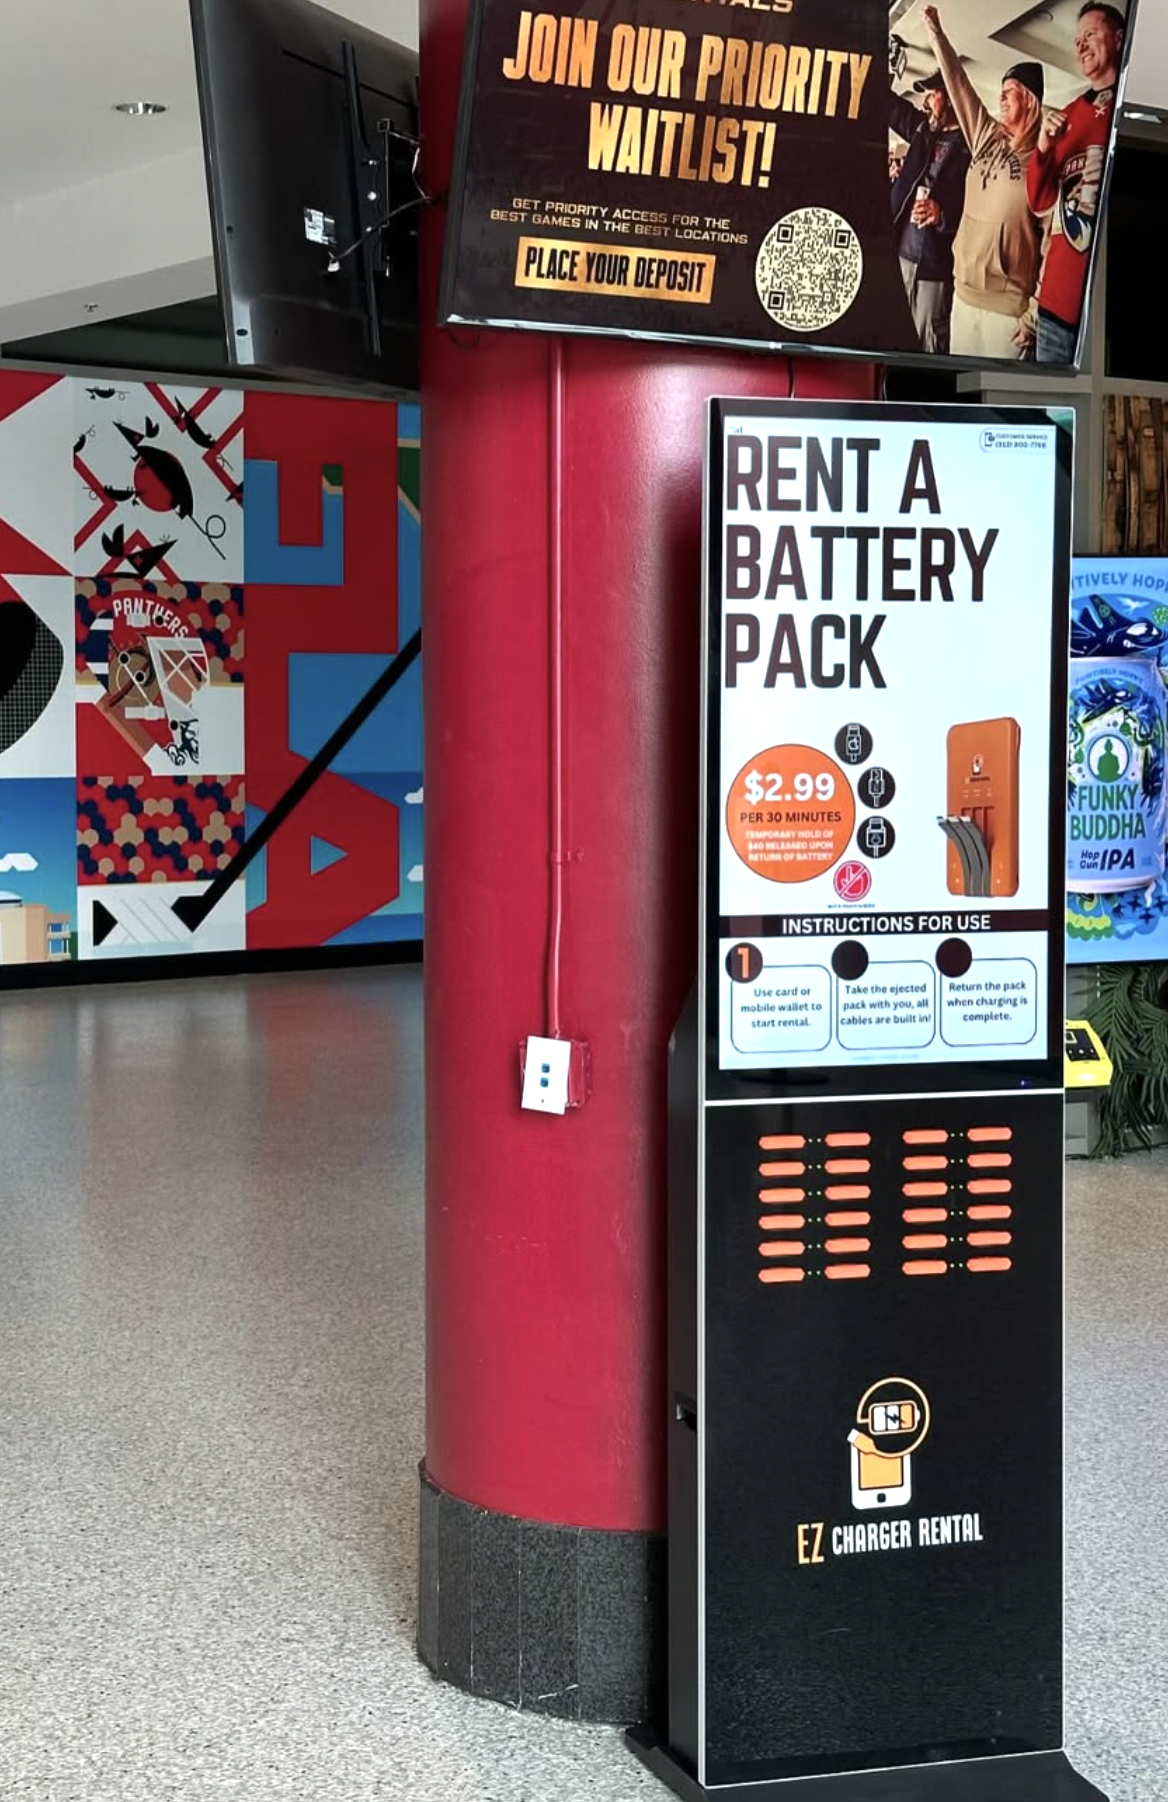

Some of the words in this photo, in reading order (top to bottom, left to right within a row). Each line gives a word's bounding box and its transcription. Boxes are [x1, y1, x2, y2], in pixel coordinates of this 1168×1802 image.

[502, 11, 598, 88] JOIN
[607, 24, 686, 99] OUR
[695, 34, 872, 120] PRIORITY
[588, 102, 777, 188] WAITLIST!
[512, 198, 541, 211] GET
[545, 202, 608, 218] PRIORITY
[612, 208, 667, 224] ACCESS
[672, 213, 699, 226] FOR
[704, 217, 731, 230] THE
[490, 210, 529, 223] BEST
[532, 214, 581, 229] GAMES
[585, 219, 599, 231] IN
[603, 220, 630, 234] THE
[634, 224, 671, 238] BEST
[675, 227, 748, 245] LOCATIONS
[524, 246, 579, 282] PLACE
[585, 251, 629, 287] YOUR
[634, 255, 706, 293] DEPOSIT
[726, 434, 881, 513] RENT
[898, 439, 941, 514] A
[726, 524, 1000, 602] BATTERY
[113, 598, 189, 639] PANTHERS
[725, 613, 887, 689] PACK
[744, 770, 835, 806] $2.99
[1078, 784, 1139, 812] FUNKY
[740, 812, 764, 823] PER
[766, 811, 782, 823] 30
[785, 810, 841, 822] MINUTES
[1070, 812, 1146, 841] BUDDHA
[746, 830, 796, 839] TEMPORARY
[798, 830, 821, 838] HOLD
[823, 830, 834, 838] OF
[765, 842, 807, 850] RELEASED
[809, 841, 833, 850] UPON
[1080, 849, 1100, 860] Hop
[748, 853, 781, 862] RETURN
[783, 853, 794, 861] OF
[796, 852, 833, 861] BATTERY
[1099, 848, 1135, 871] IPA
[782, 917, 913, 934] INSTRUCTIONS
[918, 916, 951, 932] FOR
[957, 915, 991, 930] USE
[737, 947, 749, 978] 1
[753, 988, 771, 997] Use
[775, 987, 797, 997] card
[800, 988, 811, 996] or
[844, 985, 868, 995] Take
[871, 984, 887, 994] the
[890, 983, 926, 995] ejected
[949, 982, 982, 992] Return
[984, 981, 1000, 991] the
[1003, 981, 1027, 993] pack
[740, 1003, 776, 1013] mobile
[778, 1002, 809, 1012] wallet
[811, 1003, 822, 1011] to
[843, 1000, 867, 1012] pack
[869, 999, 891, 1009] with
[892, 1000, 914, 1011] you,
[916, 998, 928, 1008] all
[947, 997, 973, 1007] when
[975, 996, 1018, 1008] charging
[1020, 996, 1028, 1005] is
[751, 1018, 775, 1028] start
[778, 1017, 811, 1027] rental.
[840, 1015, 872, 1025] cables
[875, 1016, 891, 1024] are
[893, 1013, 917, 1024] built
[918, 1013, 931, 1022] in!
[963, 1011, 1012, 1024] complete.
[797, 1522, 824, 1565] EZ
[832, 1520, 912, 1555] CHARGER
[918, 1513, 983, 1547] RENTAL
